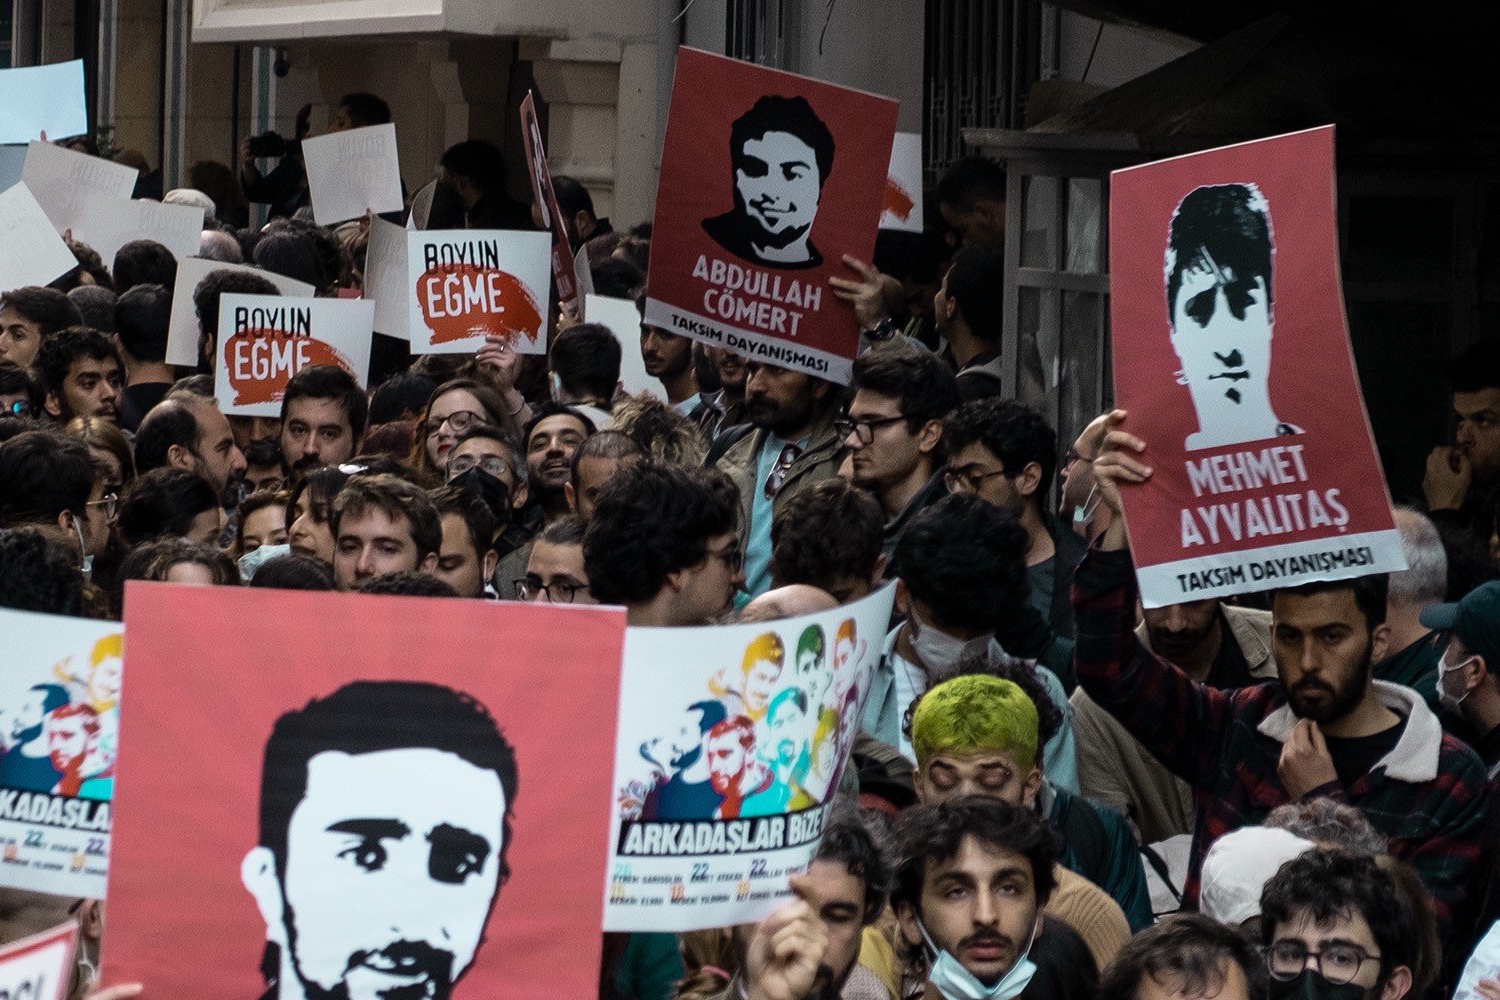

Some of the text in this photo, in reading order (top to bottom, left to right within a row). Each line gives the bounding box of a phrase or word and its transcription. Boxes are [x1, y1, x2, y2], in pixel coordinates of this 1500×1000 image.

[424, 239, 499, 274] BOYUN
[426, 272, 505, 318] EĞME
[692, 254, 822, 311] ABDULLAH
[235, 306, 311, 338] BOYUN
[703, 288, 803, 337] CÖMERT
[727, 334, 829, 373] DAYANIŞMASI
[1184, 444, 1309, 497] MEHMET
[1180, 488, 1349, 549] AYVALITAŞ
[1250, 547, 1375, 581] DAYANIŞMASI
[624, 816, 785, 855] ARKADAŞLAR
[691, 862, 709, 880] 22
